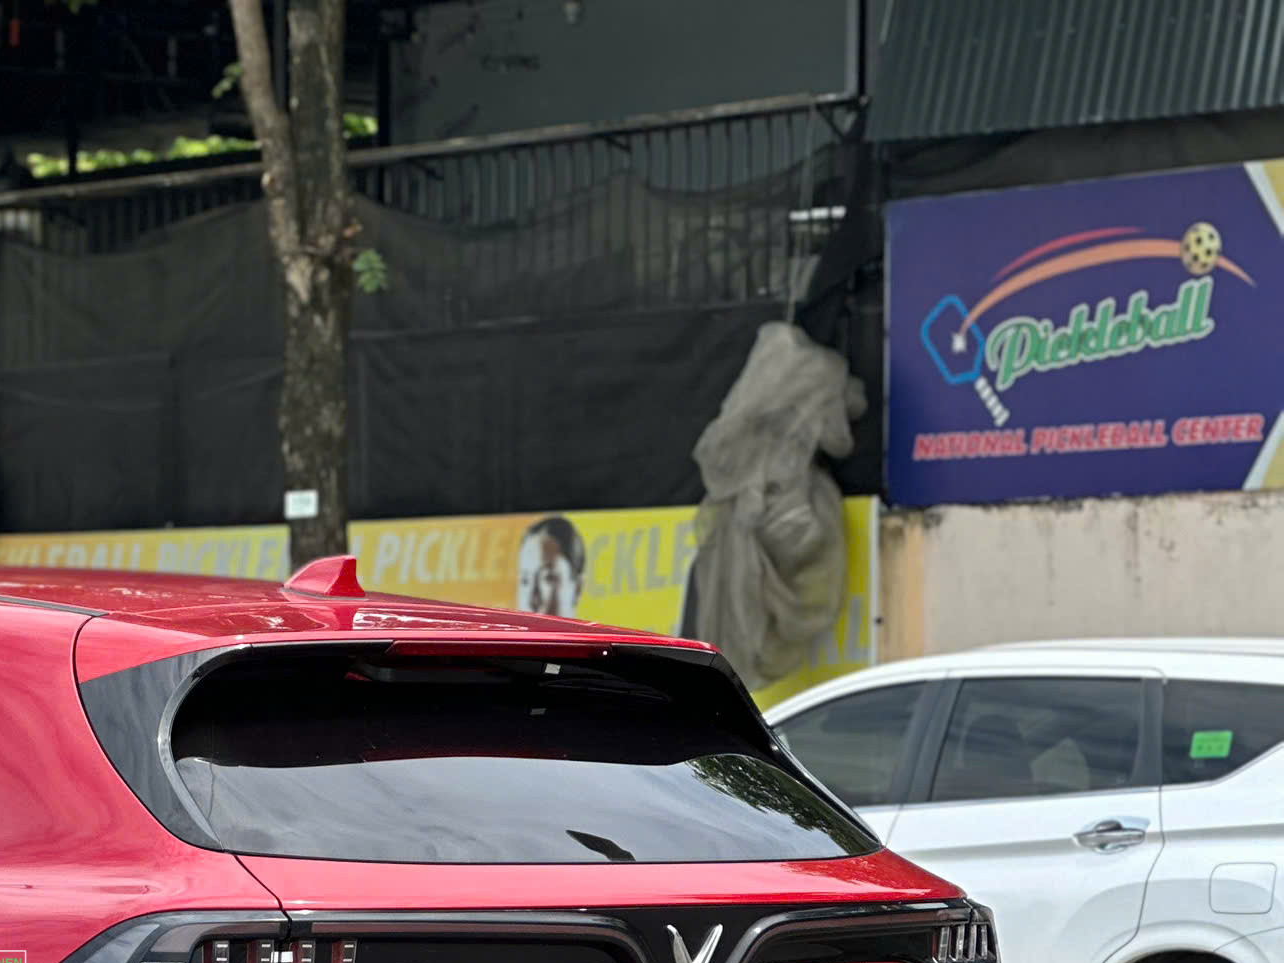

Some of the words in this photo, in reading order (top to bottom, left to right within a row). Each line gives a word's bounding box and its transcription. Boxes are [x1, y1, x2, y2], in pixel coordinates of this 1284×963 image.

[985, 277, 1214, 391] Pickleball
[913, 431, 1027, 461] NATIONAL
[1030, 422, 1168, 455] PICKLEBALL
[1172, 414, 1265, 446] CENTER
